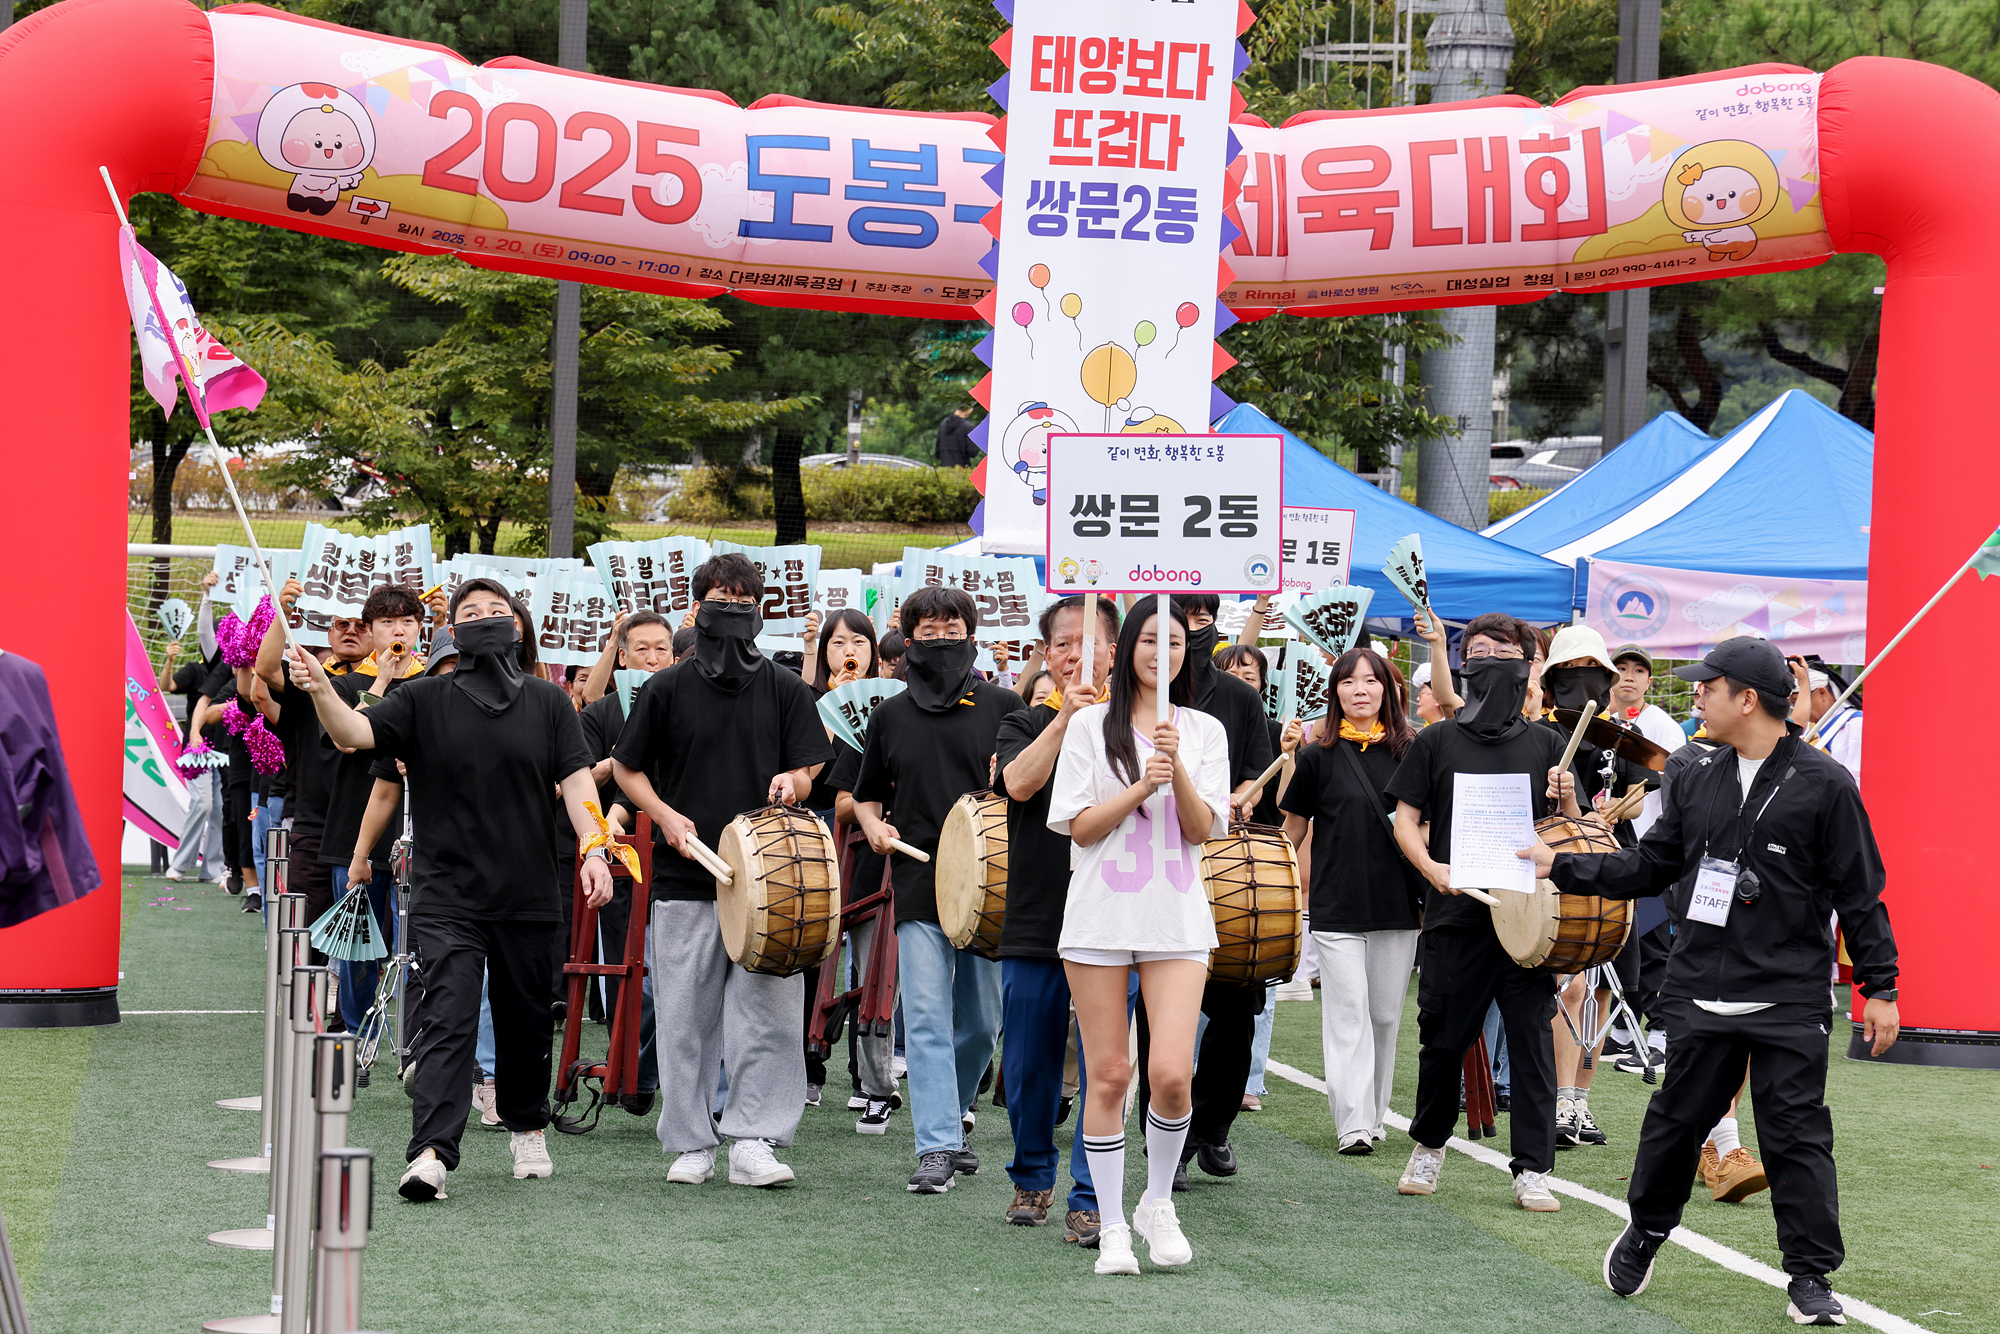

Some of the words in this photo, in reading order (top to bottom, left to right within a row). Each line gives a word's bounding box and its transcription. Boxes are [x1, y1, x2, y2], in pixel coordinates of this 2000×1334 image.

[1030, 35, 1214, 101] 태양보다
[1736, 82, 1811, 96] dobong
[1695, 108, 1719, 121] 같이
[1755, 96, 1793, 113] 행복한
[1797, 96, 1812, 109] 도봉
[1049, 109, 1185, 172] 뜨겁다
[421, 89, 703, 225] 2025
[1026, 180, 1199, 244] 쌍문2동
[397, 222, 425, 237] 일시
[431, 230, 467, 247] 2025.
[473, 235, 489, 249] 9.
[495, 238, 525, 254] 20.
[532, 242, 565, 260] (토)
[567, 250, 616, 266] 09:00
[637, 259, 680, 276] 17:00
[699, 267, 724, 281] 장소
[728, 270, 843, 291] 다락원체육공원
[1574, 270, 1596, 281] 문의
[1599, 267, 1620, 277] 02)
[1622, 257, 1697, 273] 990-4141~2
[940, 285, 991, 300] 도봉구
[1320, 287, 1355, 298] 바로선
[1357, 286, 1379, 296] 병원
[1446, 276, 1510, 291] 대성실업
[1524, 273, 1554, 286] 창원
[1245, 289, 1296, 300] Rinnai
[1107, 445, 1130, 462] 같이
[1134, 444, 1161, 462] 변화,
[1165, 444, 1202, 462] 행복한
[1207, 445, 1225, 462] 도봉
[1069, 493, 1160, 538] 쌍문
[1182, 494, 1259, 538] 2동
[1282, 539, 1298, 563] 문
[1306, 540, 1340, 566] 1동
[1128, 564, 1202, 586] dobong
[763, 583, 811, 620] 2동
[976, 594, 1031, 627] 2동
[1694, 894, 1729, 910] STAFF
